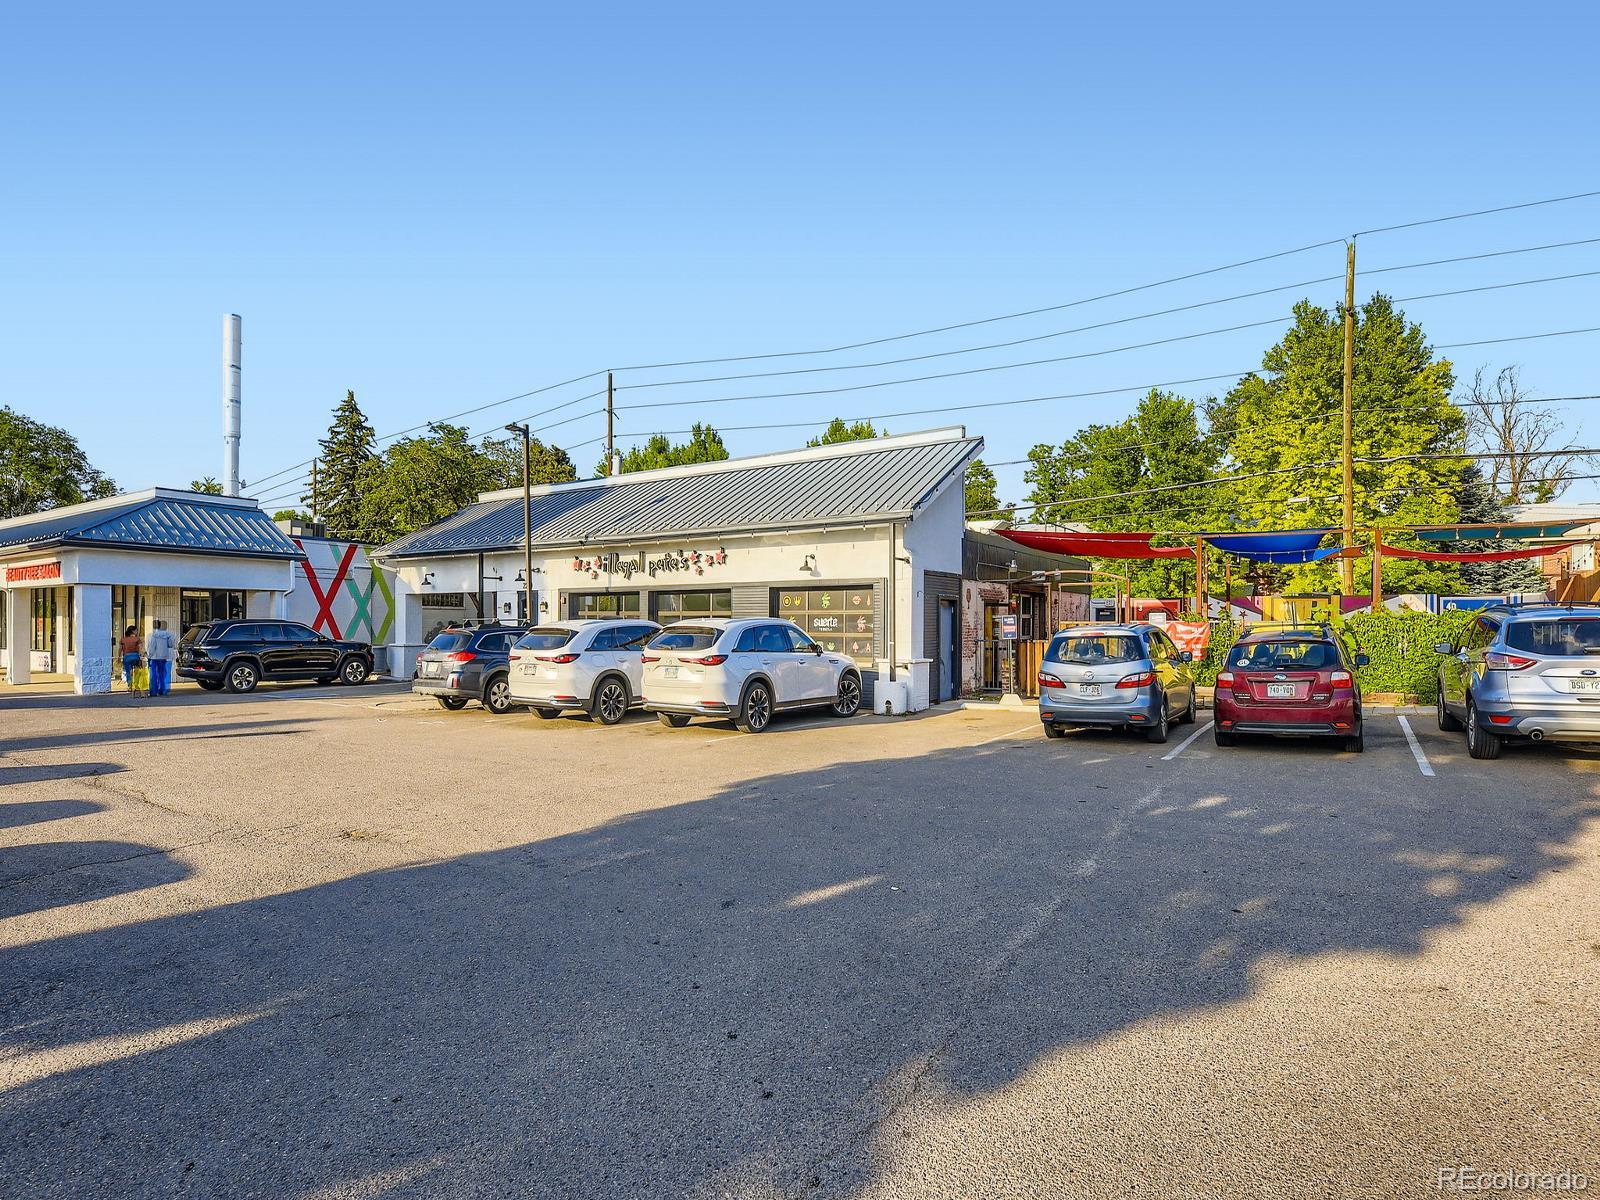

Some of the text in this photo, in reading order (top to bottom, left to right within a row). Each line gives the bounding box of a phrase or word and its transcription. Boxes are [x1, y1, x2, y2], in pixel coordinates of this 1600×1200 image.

[6, 567, 27, 582] BEAUTY
[603, 549, 690, 580] illegal pete's
